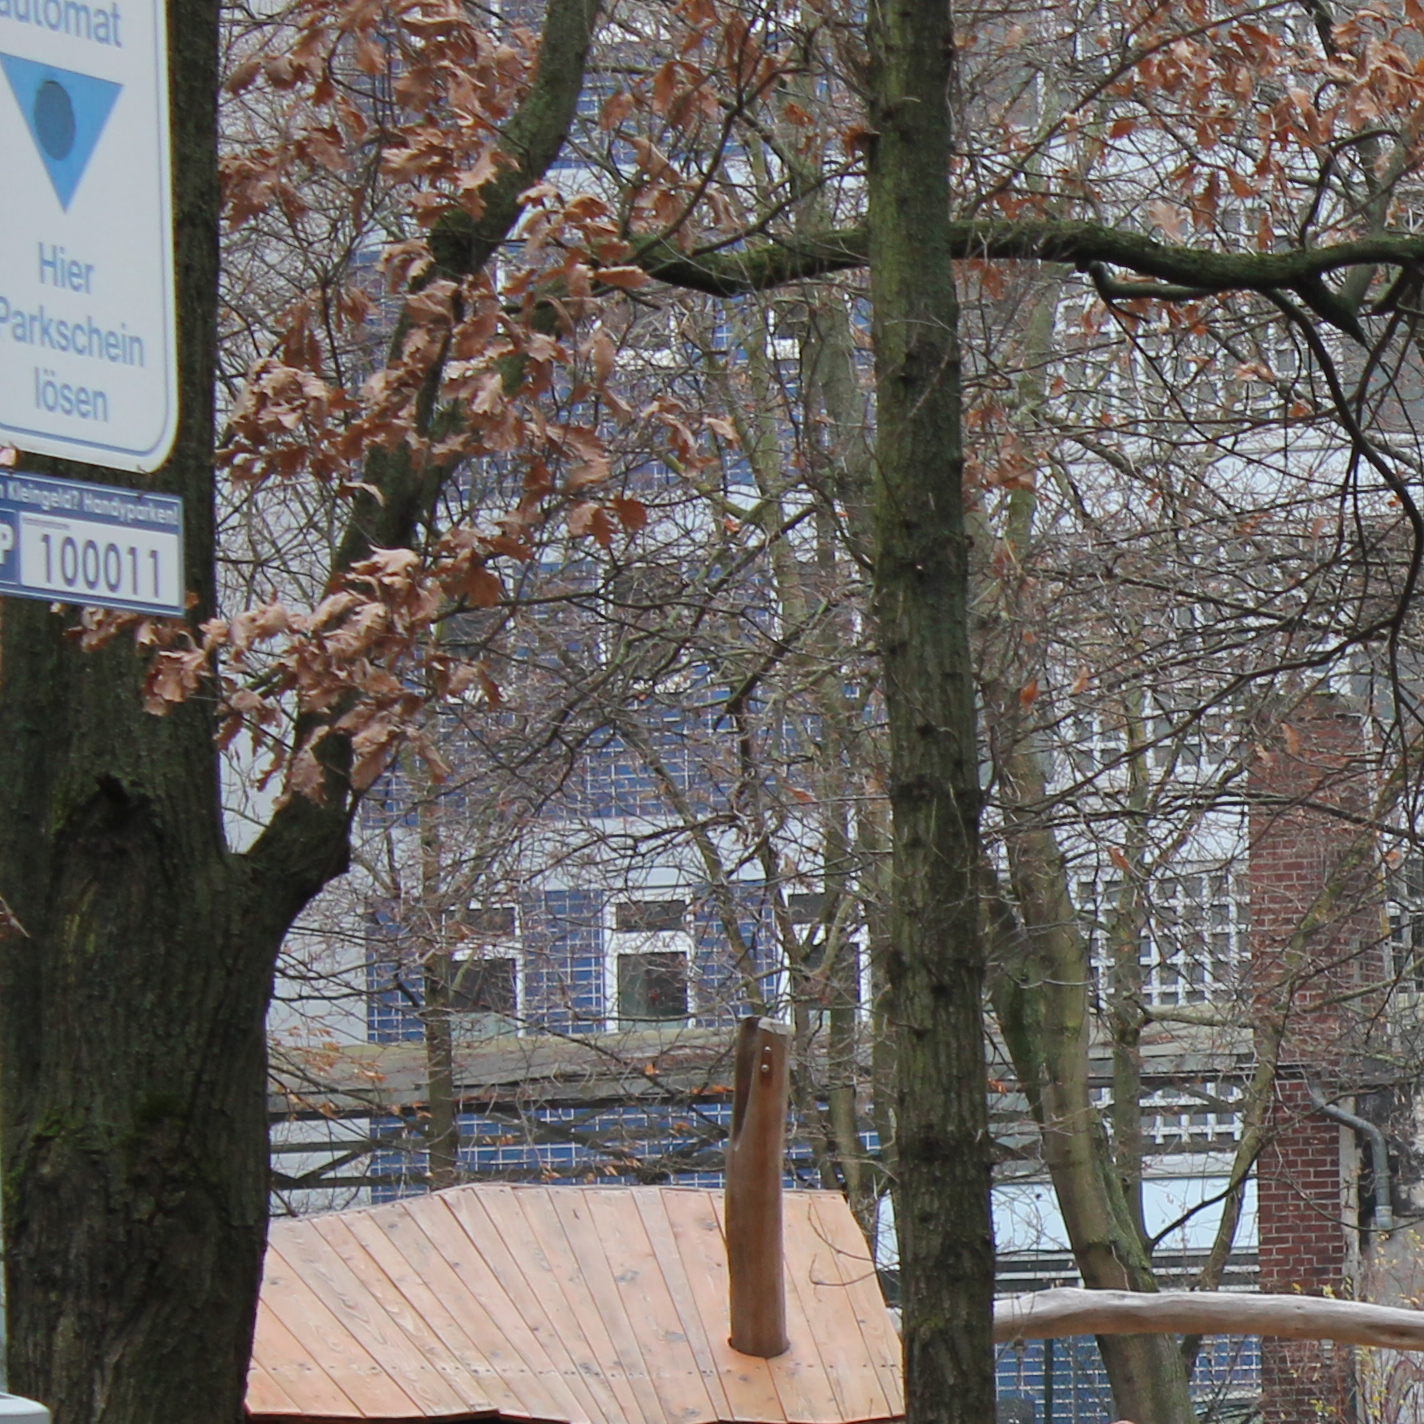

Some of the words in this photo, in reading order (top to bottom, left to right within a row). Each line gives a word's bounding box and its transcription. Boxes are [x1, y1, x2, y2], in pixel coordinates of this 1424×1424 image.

[39, 241, 95, 295] Hier
[34, 366, 109, 424] lösen
[40, 533, 160, 598] 100011
